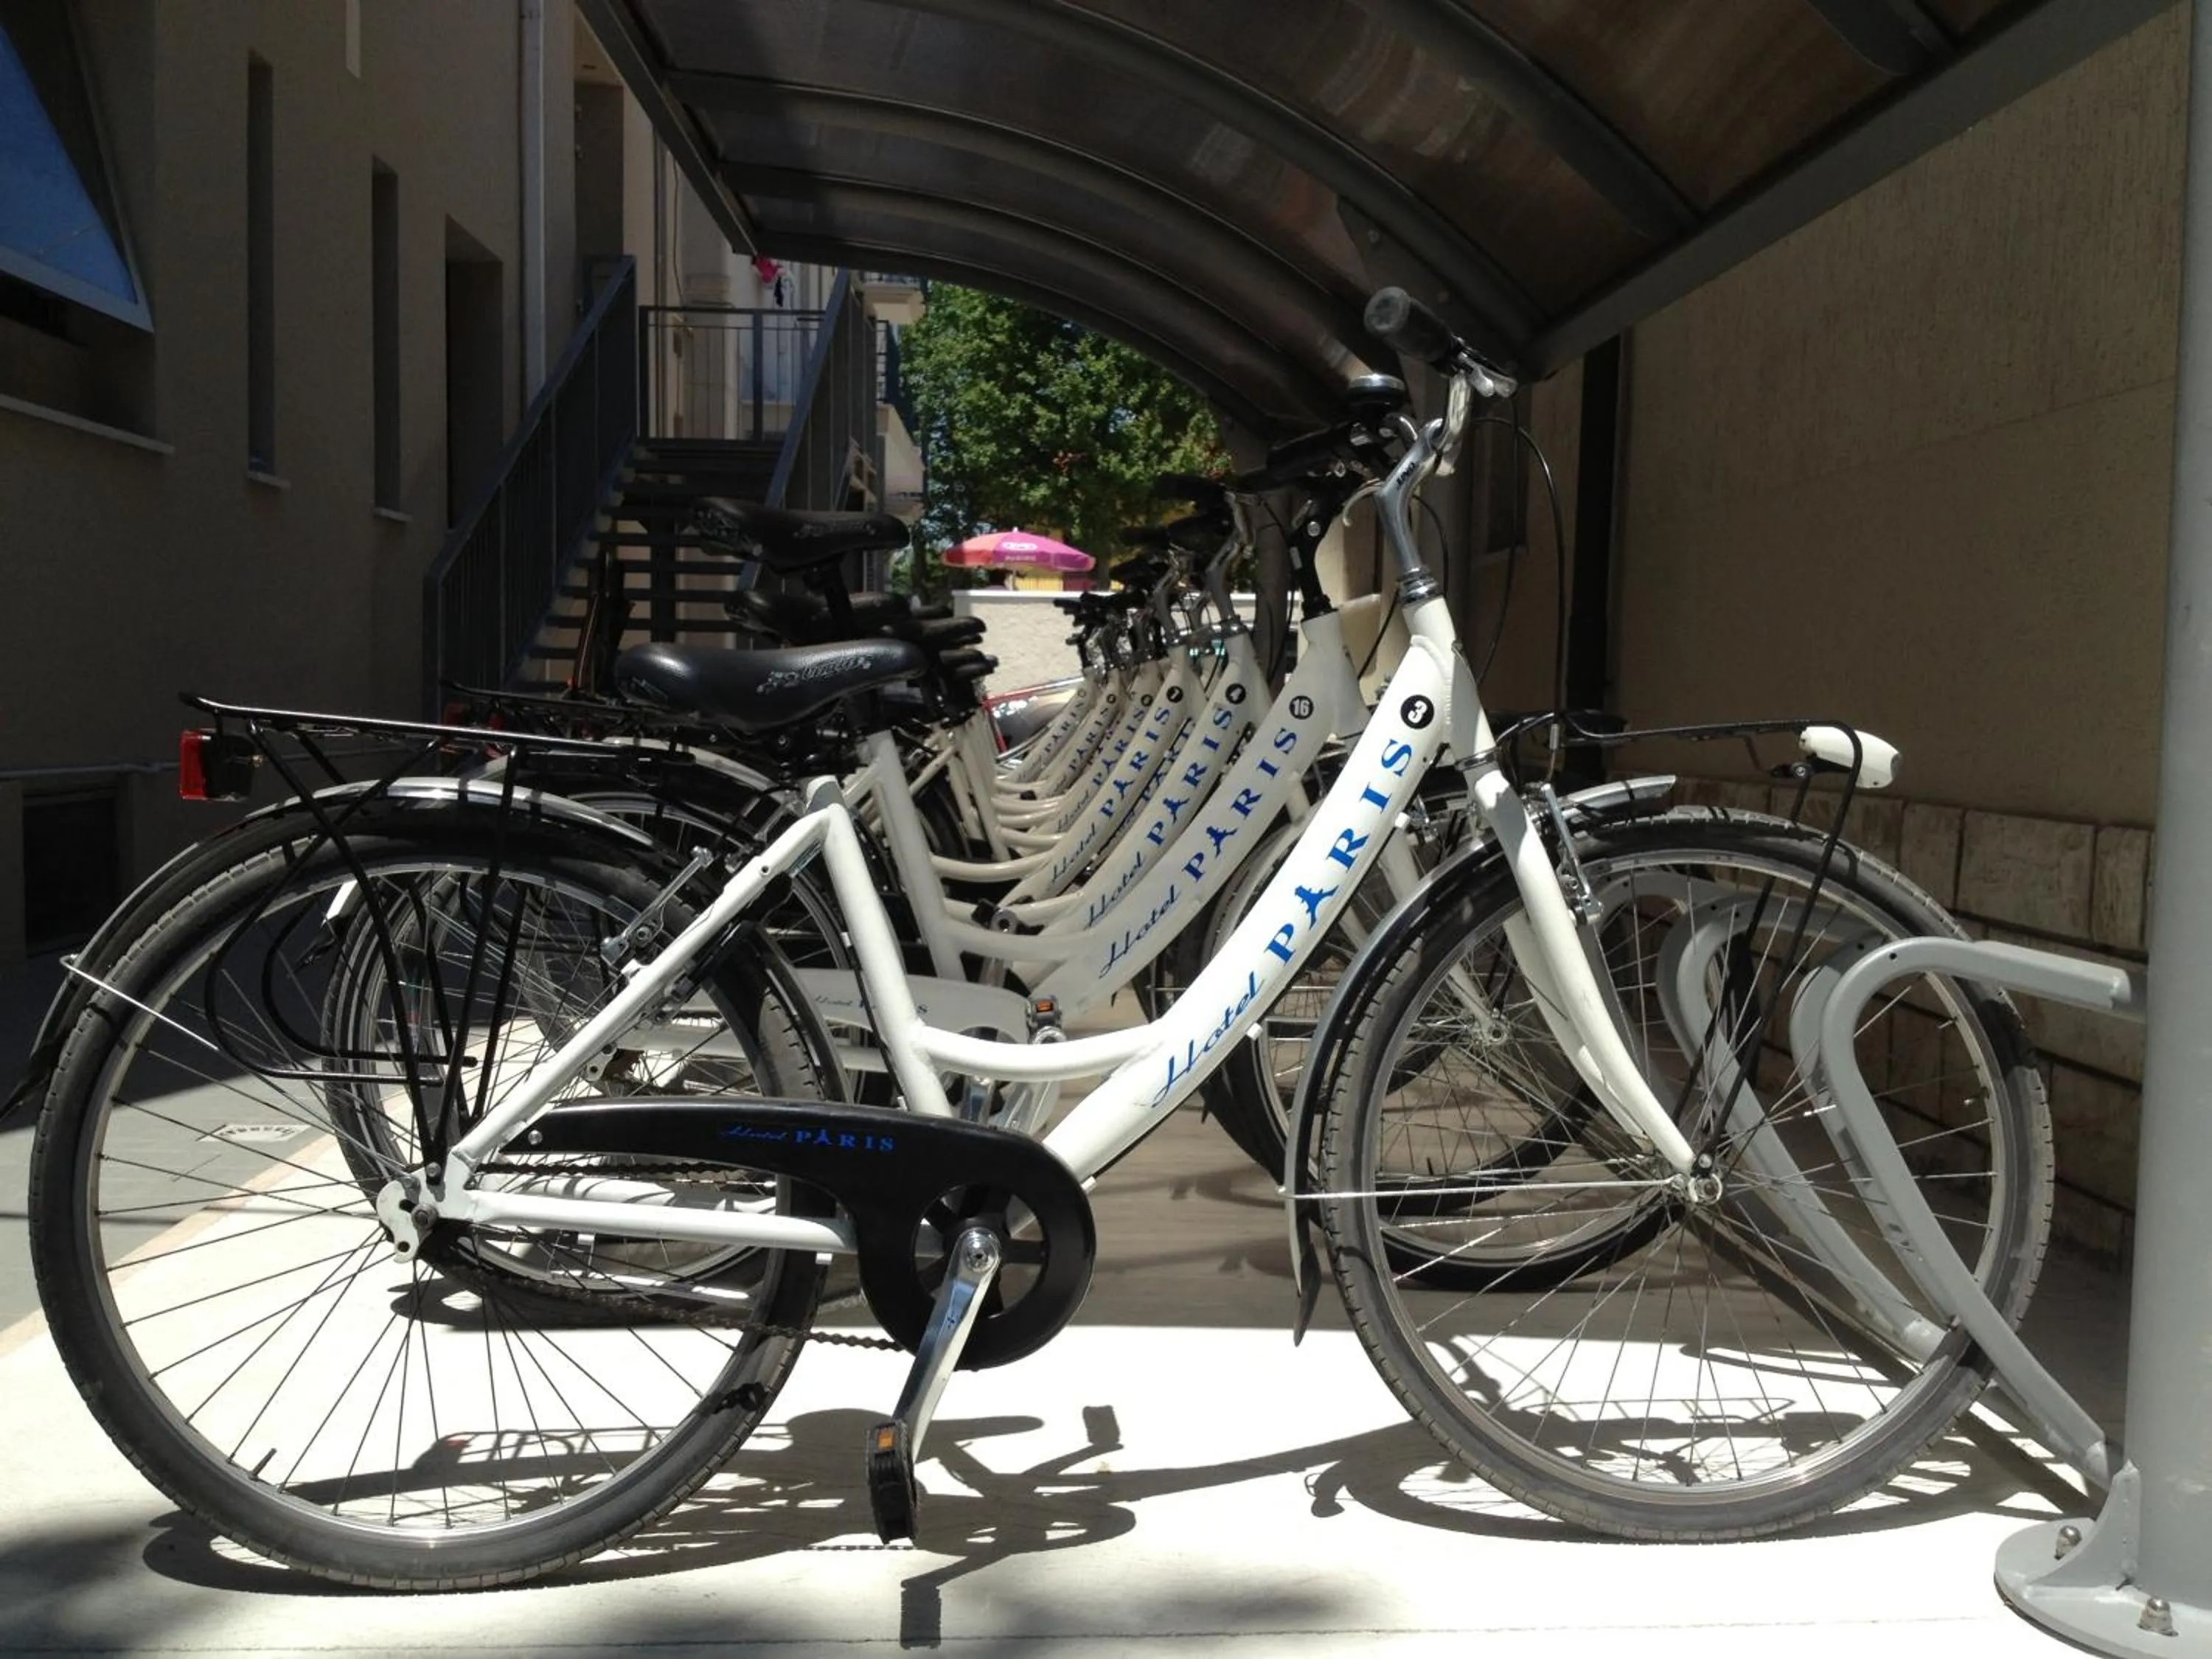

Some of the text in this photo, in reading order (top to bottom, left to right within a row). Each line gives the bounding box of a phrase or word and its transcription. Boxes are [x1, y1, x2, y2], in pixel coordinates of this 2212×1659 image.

[1092, 707, 1144, 786] PARIS
[1293, 698, 1310, 717] 16
[1408, 700, 1427, 723] 3
[1099, 708, 1171, 818] PARIS
[1082, 851, 1146, 931] Hotel
[1146, 707, 1232, 846] PARIS
[1098, 727, 1297, 980] Hotel PARIS
[1152, 738, 1413, 1107] Hotel PARIS
[795, 1128, 894, 1152] PARIS
